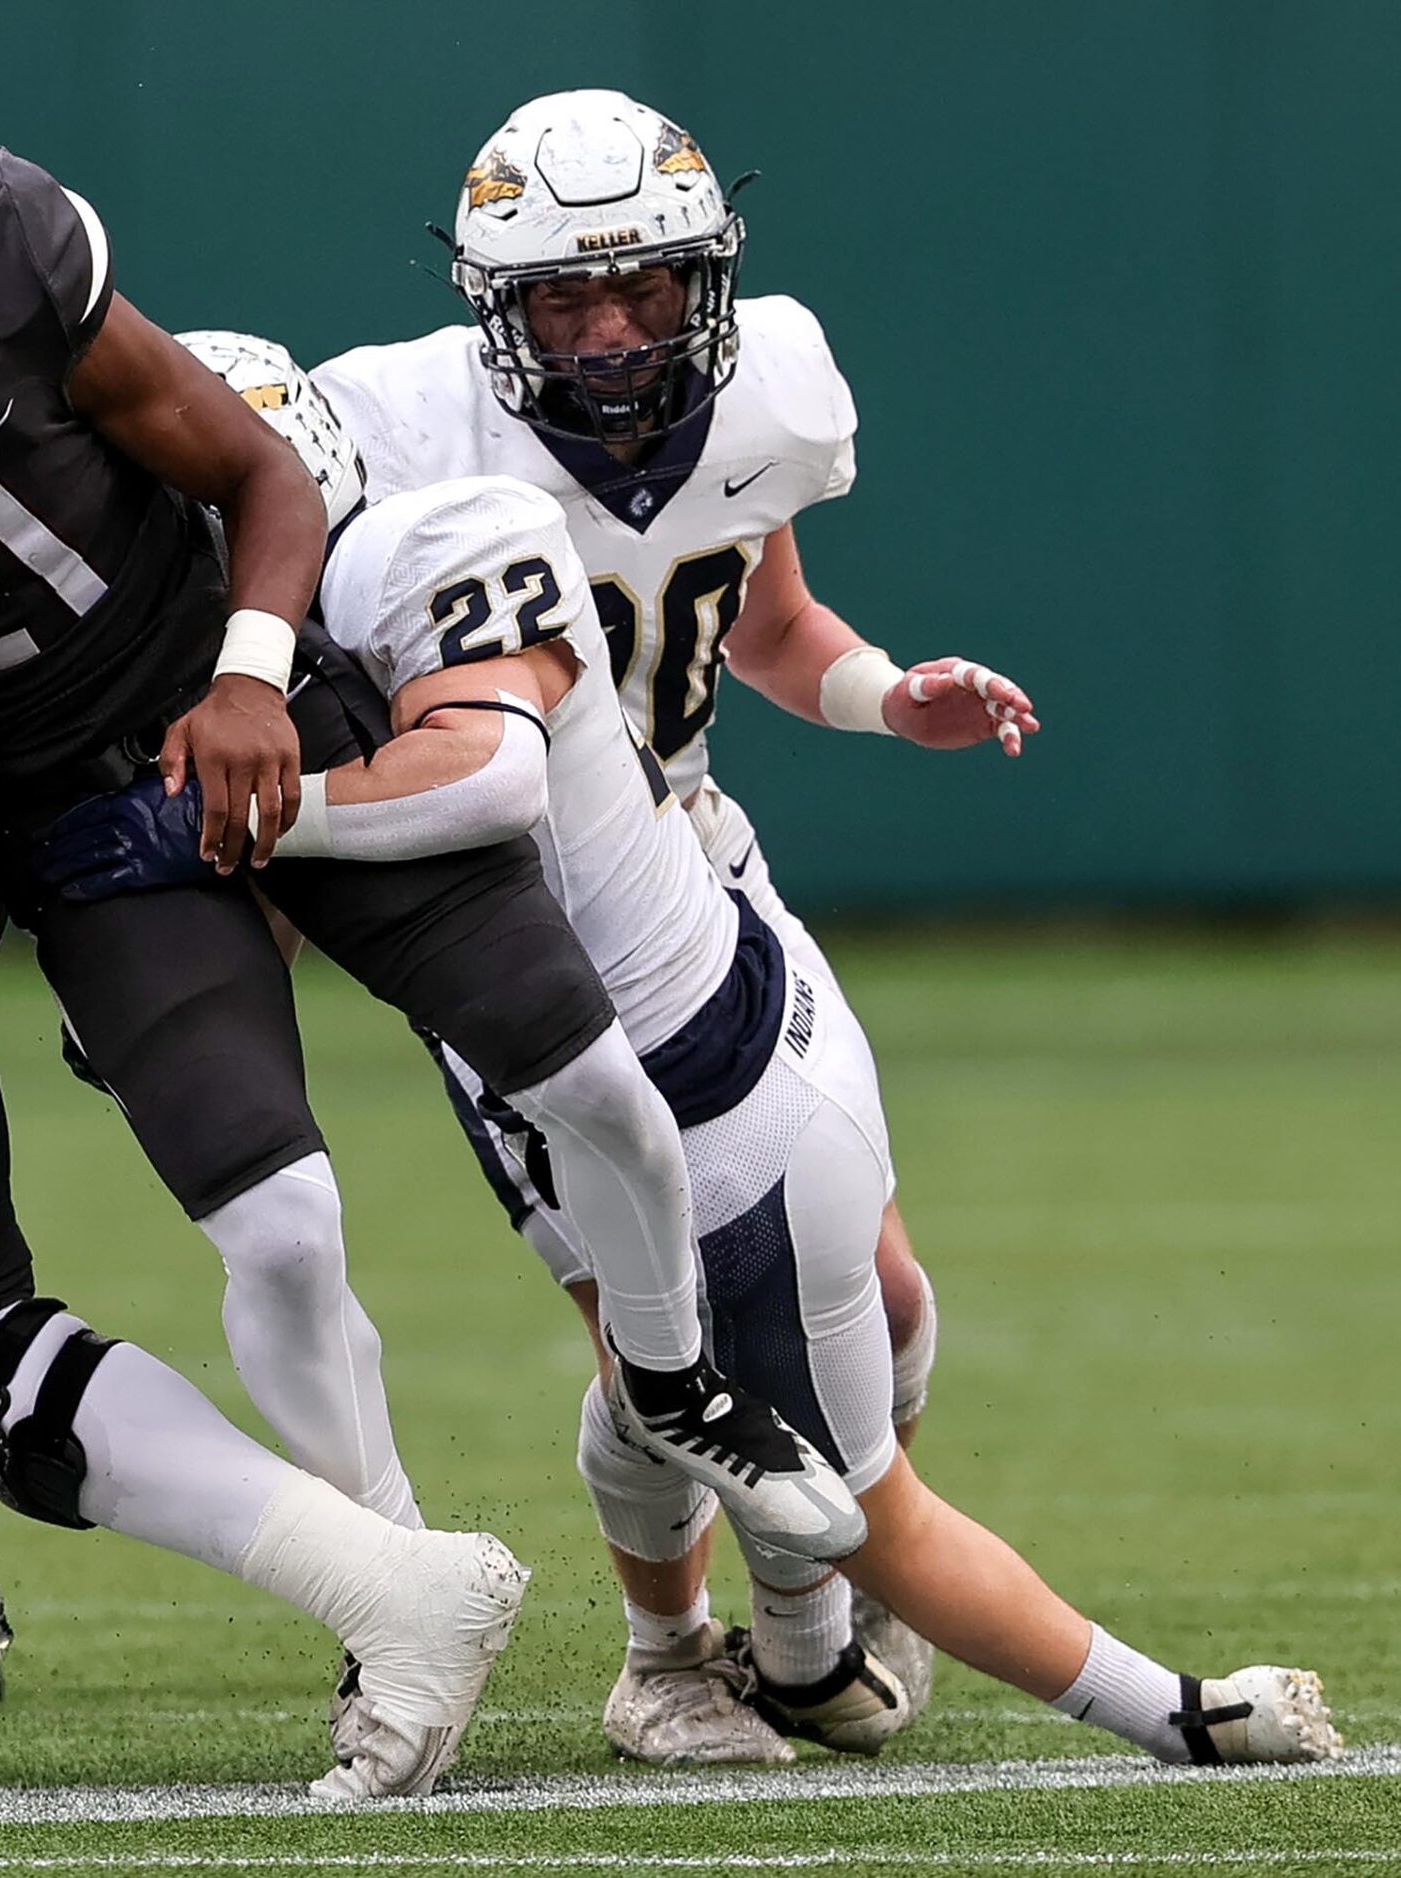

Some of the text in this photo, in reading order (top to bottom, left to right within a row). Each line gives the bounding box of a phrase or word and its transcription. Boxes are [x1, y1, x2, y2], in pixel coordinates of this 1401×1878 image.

[576, 227, 643, 253] KELLER
[426, 555, 568, 669] 22
[784, 969, 816, 1060] INDIANS
